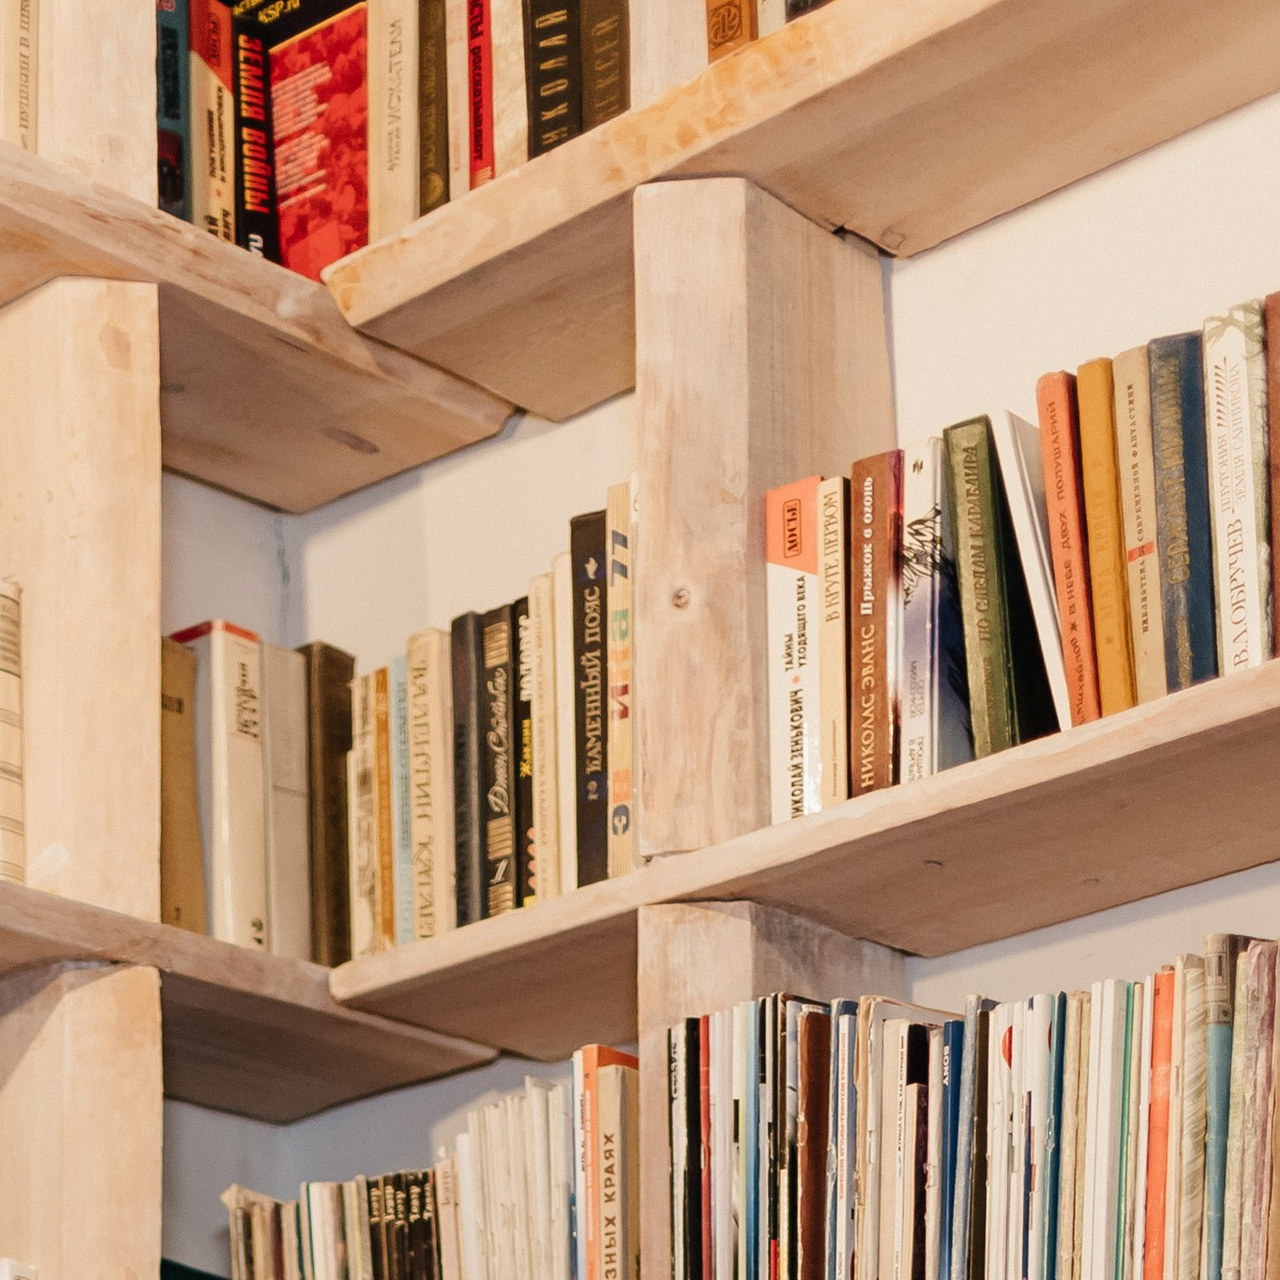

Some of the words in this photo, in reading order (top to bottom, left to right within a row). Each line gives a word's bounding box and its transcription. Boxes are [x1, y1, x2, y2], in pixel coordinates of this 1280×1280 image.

[238, 34, 265, 122] ЗЕМЛЯ
[241, 127, 271, 214] ВОЙНЫ
[1046, 400, 1065, 500] ПОЛУШАРИЙ
[1234, 454, 1247, 504] ЗЕМЛЯ
[823, 491, 838, 554] ПЕРВОМ
[862, 477, 874, 523] огонь
[1057, 510, 1072, 551] ДВУХ
[796, 575, 806, 602] ВЕКА
[824, 558, 840, 607] КРУГЕ
[860, 543, 874, 615] Прыжок
[971, 542, 991, 613] СЛЕДАМ
[1064, 559, 1075, 600] НЕБЕ
[585, 586, 601, 643] ПОЯС
[796, 604, 807, 666] УХОДЯЩЕГО
[825, 611, 840, 622] В
[784, 633, 794, 672] ТАЙНЫ
[861, 623, 876, 689] ЭВАНС
[580, 650, 603, 774] КАМЕННЫЙ
[790, 688, 804, 759] ЗЕНЬКОВИЧ
[861, 693, 876, 788] НИКОЛАС
[942, 1046, 950, 1086] SONY
[601, 1132, 616, 1203] КРАЯХ
